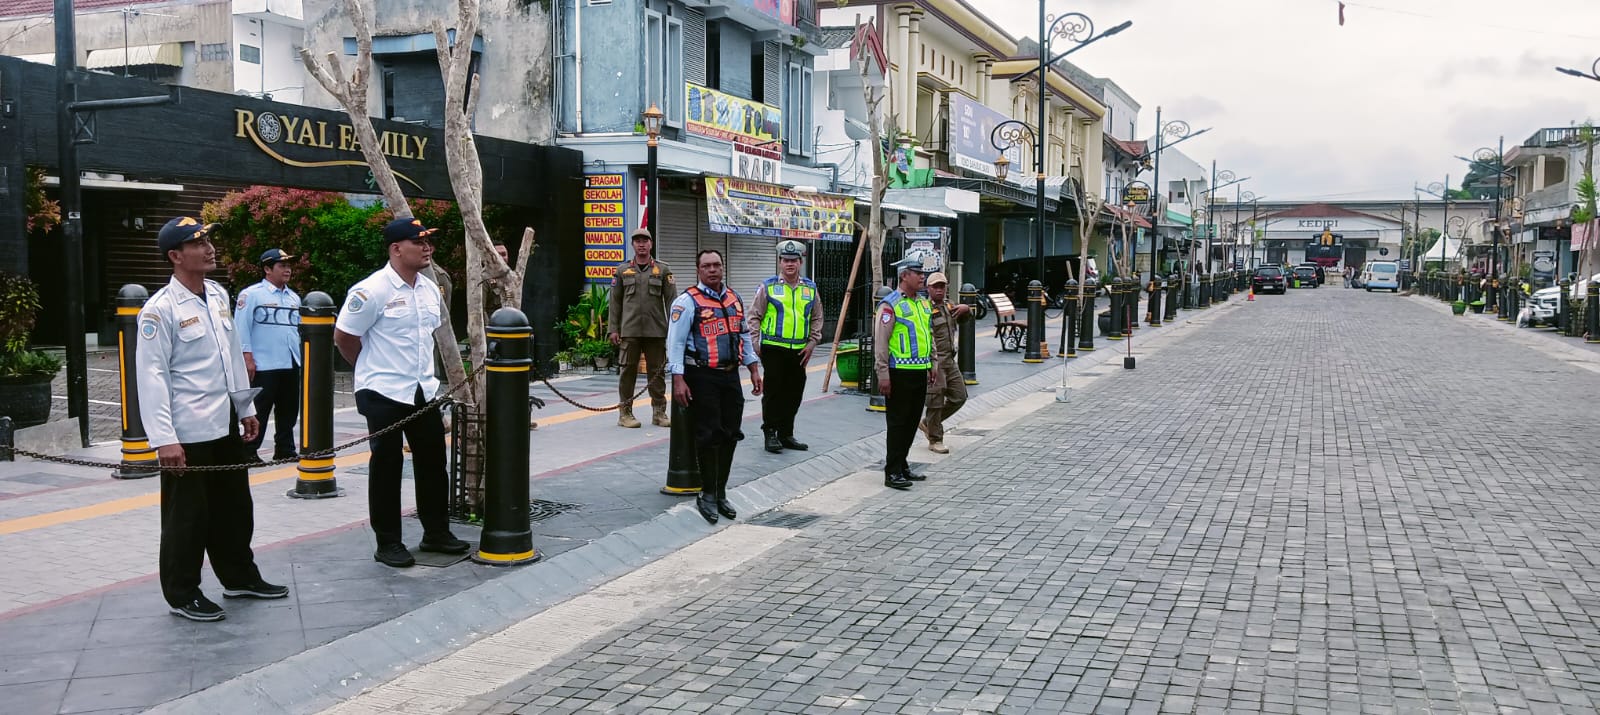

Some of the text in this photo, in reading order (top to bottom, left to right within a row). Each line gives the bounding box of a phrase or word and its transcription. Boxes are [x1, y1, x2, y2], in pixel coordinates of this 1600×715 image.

[234, 108, 334, 149] ROYAL
[739, 155, 776, 182] RAPI
[590, 176, 621, 186] ERAGAM
[585, 190, 621, 200] SEKOLAH
[591, 203, 616, 213] PNS
[585, 217, 622, 227] STEMPEL
[1298, 219, 1338, 228] KEDIRI
[585, 232, 622, 244] NAMA DADA
[586, 250, 622, 260] GORDON
[586, 267, 617, 276] VANDE
